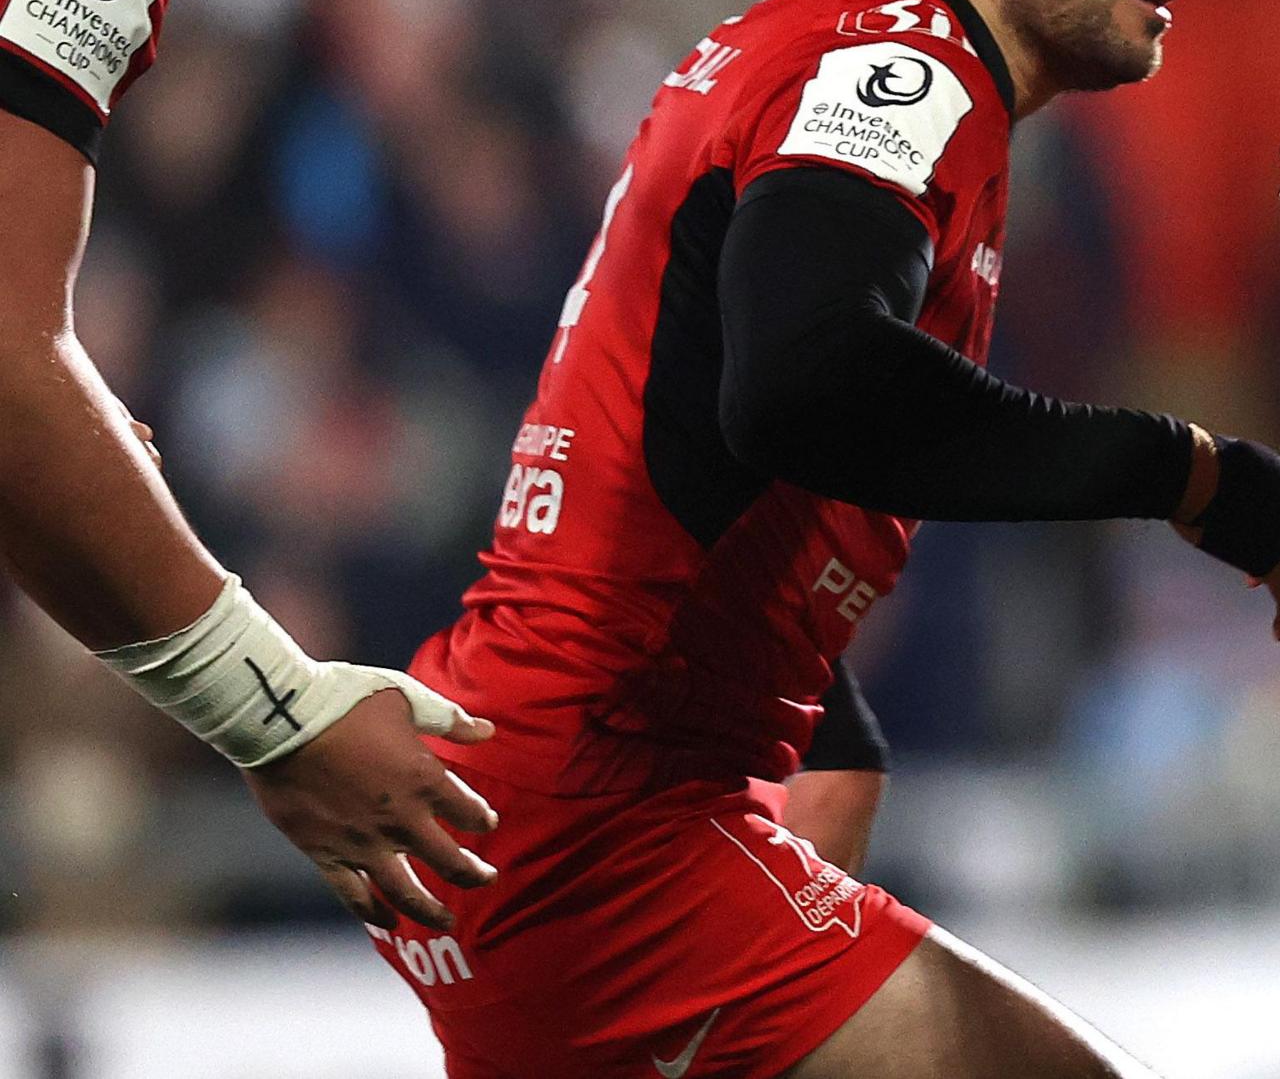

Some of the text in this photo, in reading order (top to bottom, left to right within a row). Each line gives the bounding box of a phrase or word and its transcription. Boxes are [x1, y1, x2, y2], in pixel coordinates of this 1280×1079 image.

[55, 41, 91, 70] CUP
[803, 119, 907, 166] CHAMPIO
[835, 141, 880, 160] CUP
